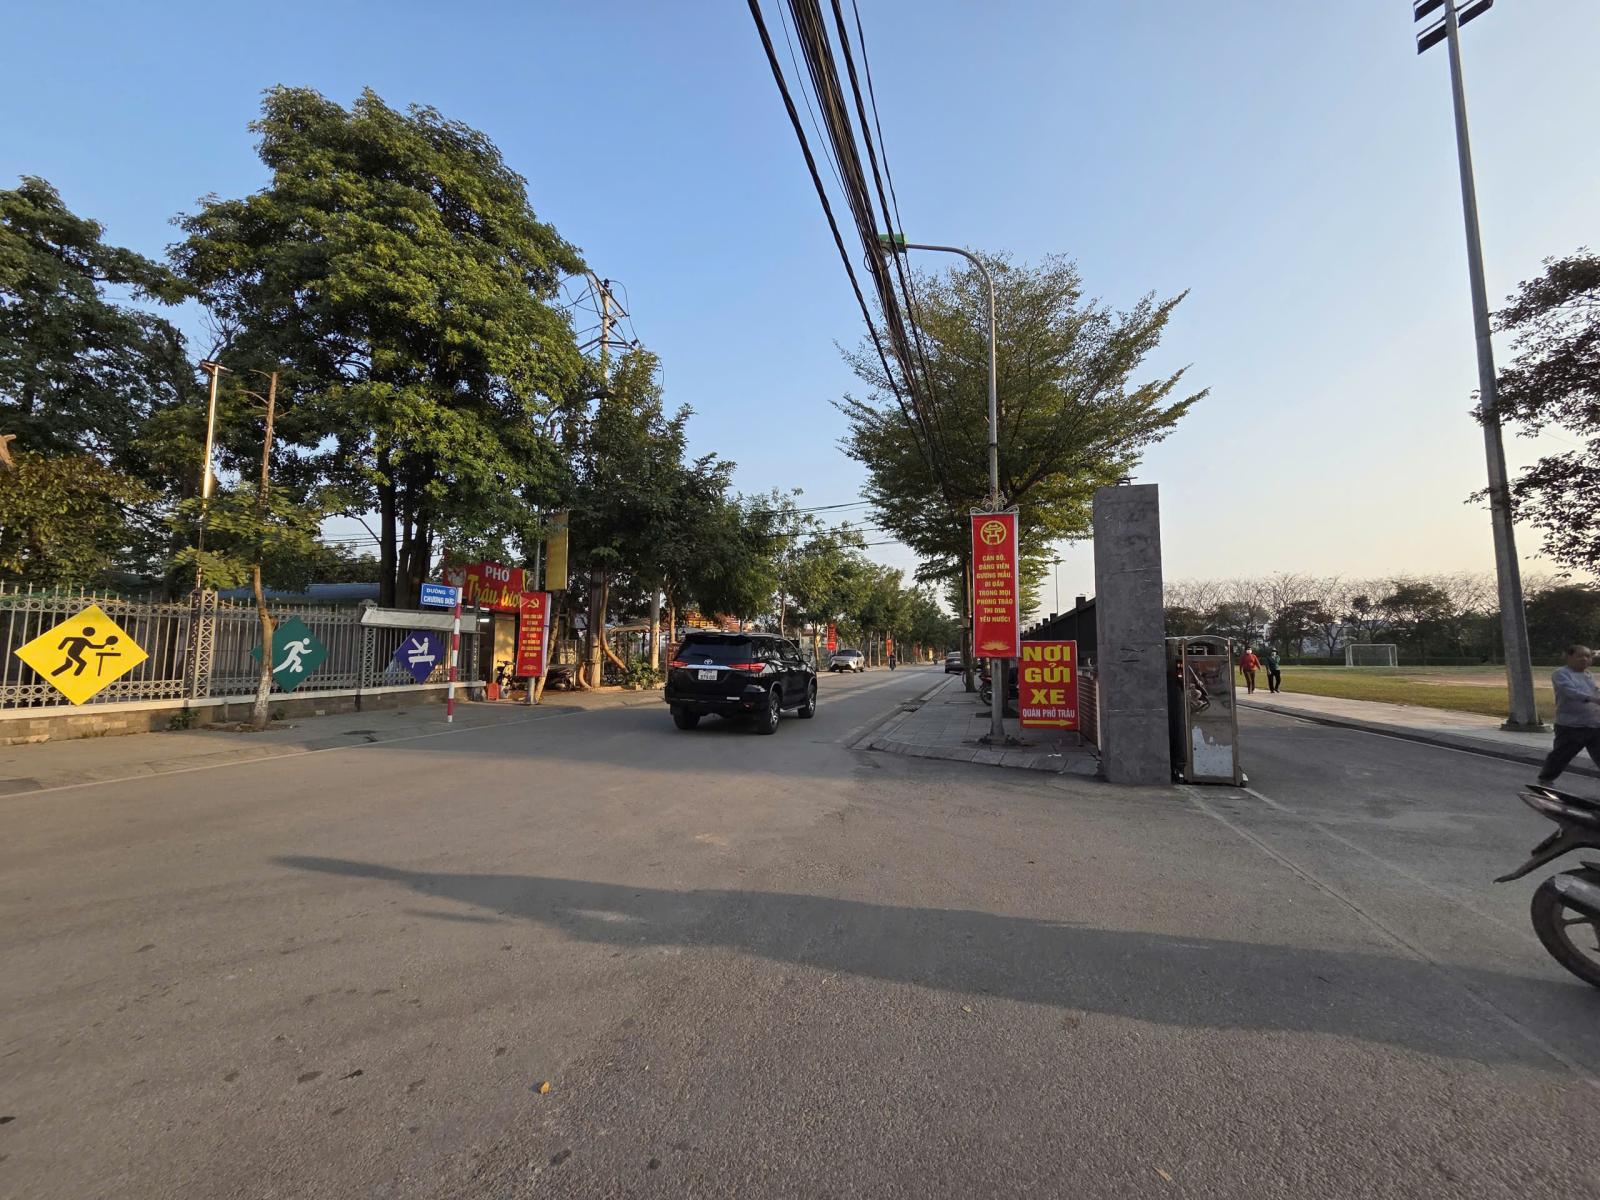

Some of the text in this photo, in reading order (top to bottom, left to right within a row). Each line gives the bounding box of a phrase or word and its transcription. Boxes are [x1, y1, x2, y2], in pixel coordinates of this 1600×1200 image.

[1022, 644, 1071, 662] NƠI
[1024, 662, 1071, 683] GỬI
[1030, 688, 1066, 705] XE
[1022, 706, 1076, 718] QUÁN PHỞ TRÂU
